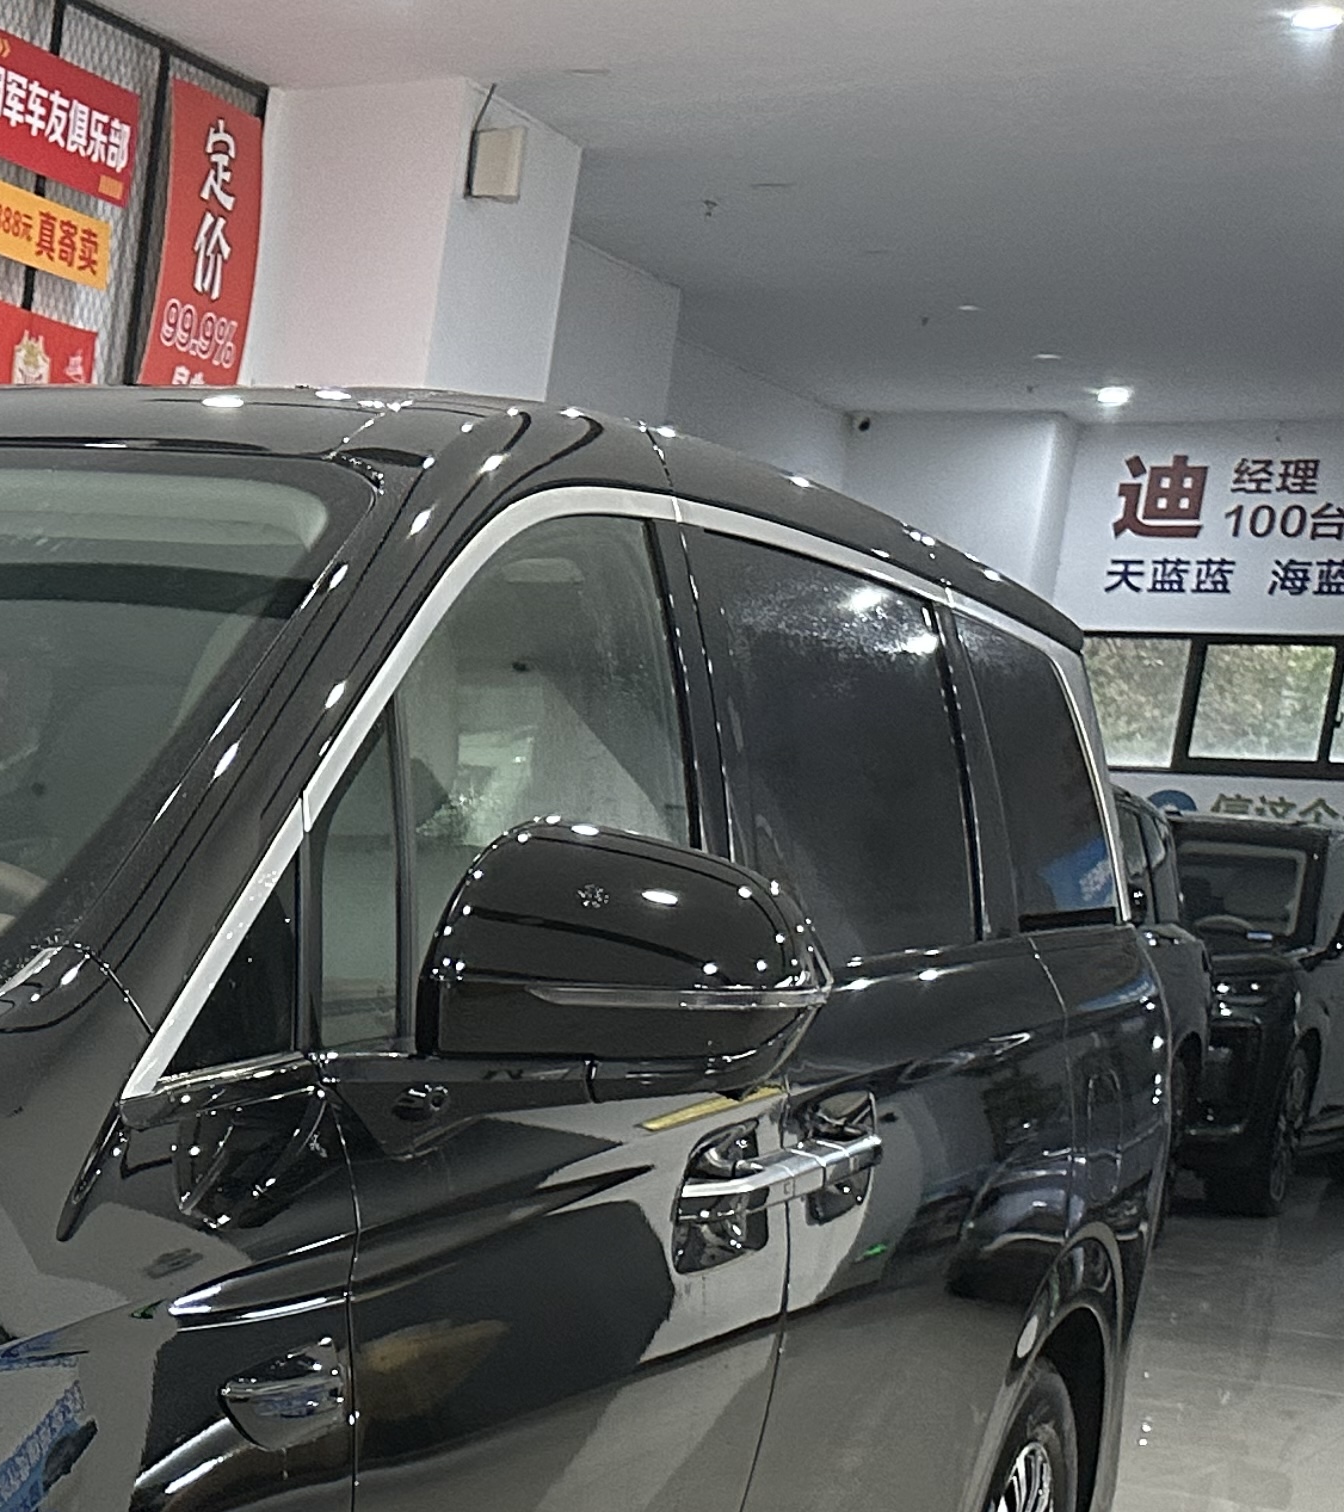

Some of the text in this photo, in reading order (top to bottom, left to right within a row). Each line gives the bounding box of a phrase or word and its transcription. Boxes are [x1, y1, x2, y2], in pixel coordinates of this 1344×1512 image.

[192, 118, 237, 302] 定价
[160, 298, 236, 369] 99.9%
[1113, 455, 1208, 538] 迪
[1230, 458, 1320, 494] 经理
[1224, 501, 1344, 540] 100台
[1104, 558, 1236, 594] 天蓝蓝
